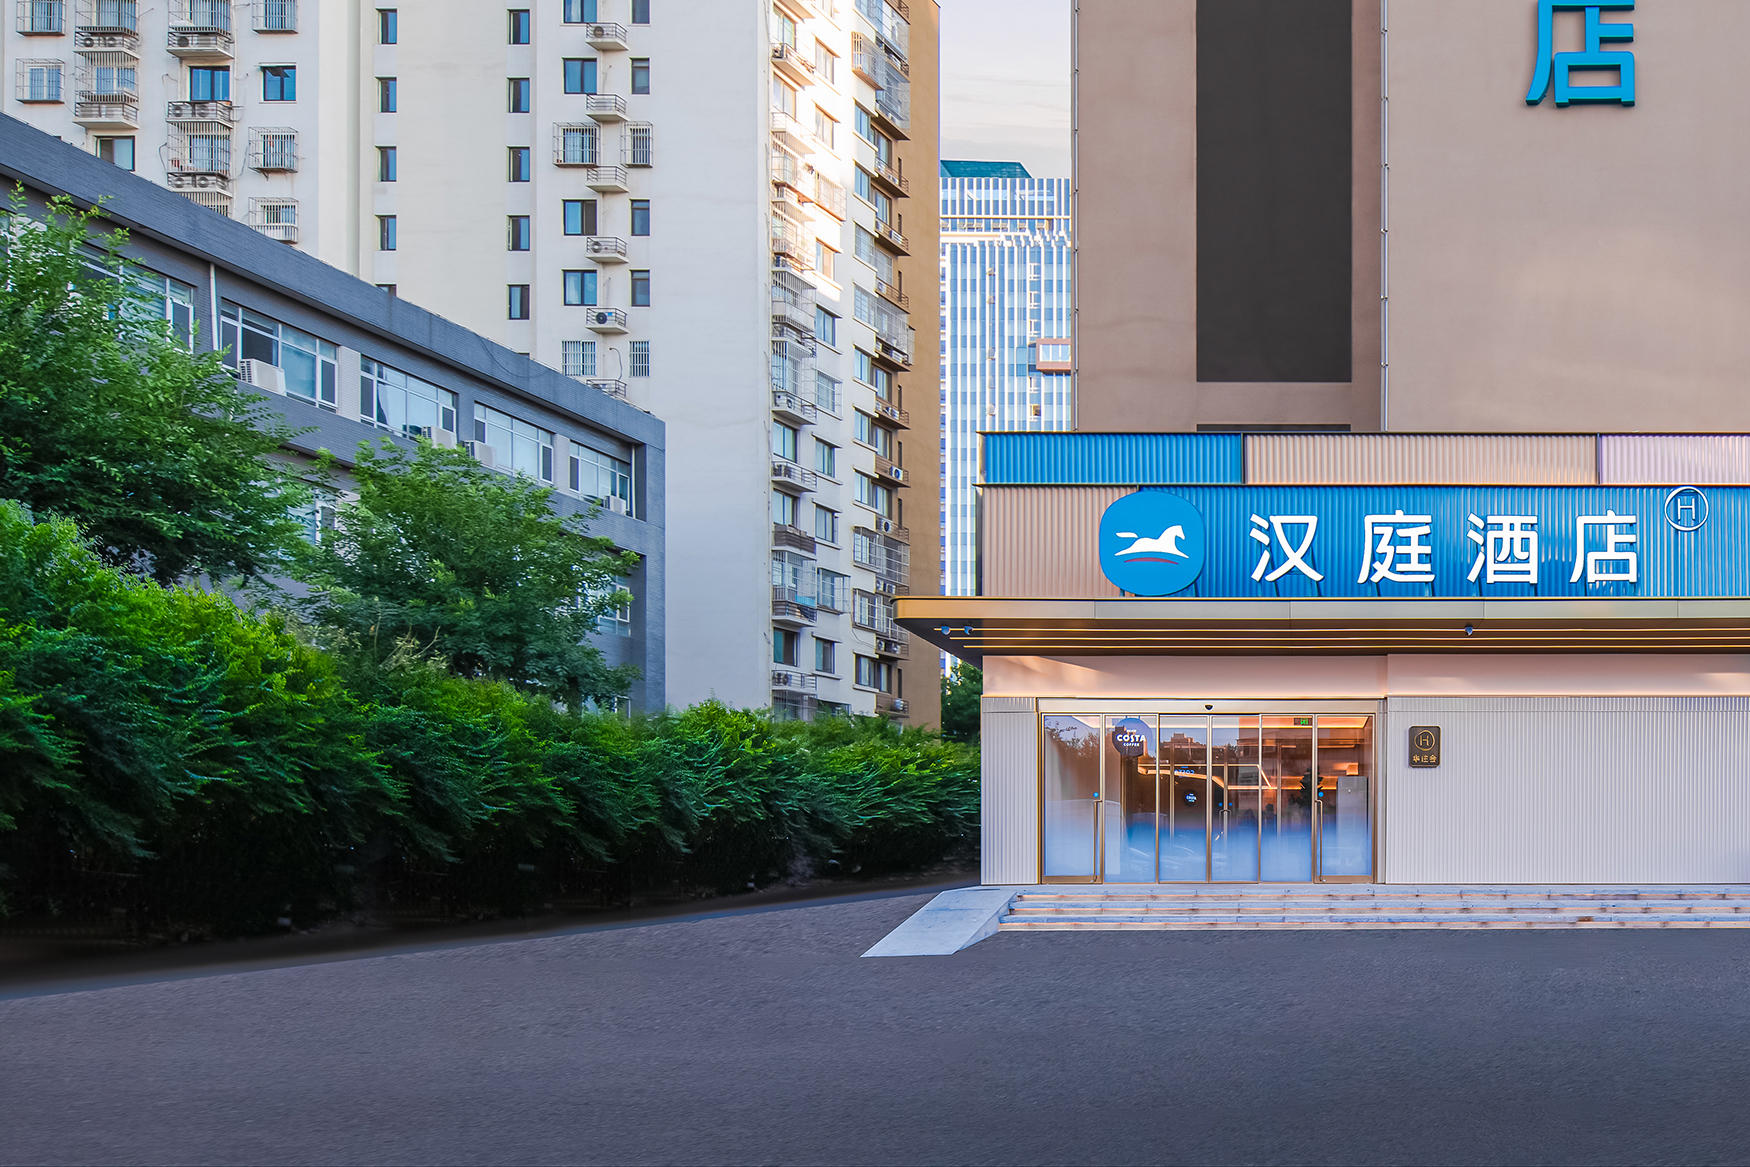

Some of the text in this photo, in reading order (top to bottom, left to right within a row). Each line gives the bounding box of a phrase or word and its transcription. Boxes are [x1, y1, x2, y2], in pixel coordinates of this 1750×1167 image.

[1249, 509, 1639, 584] 汉庭酒店
[1116, 734, 1147, 743] COSTA
